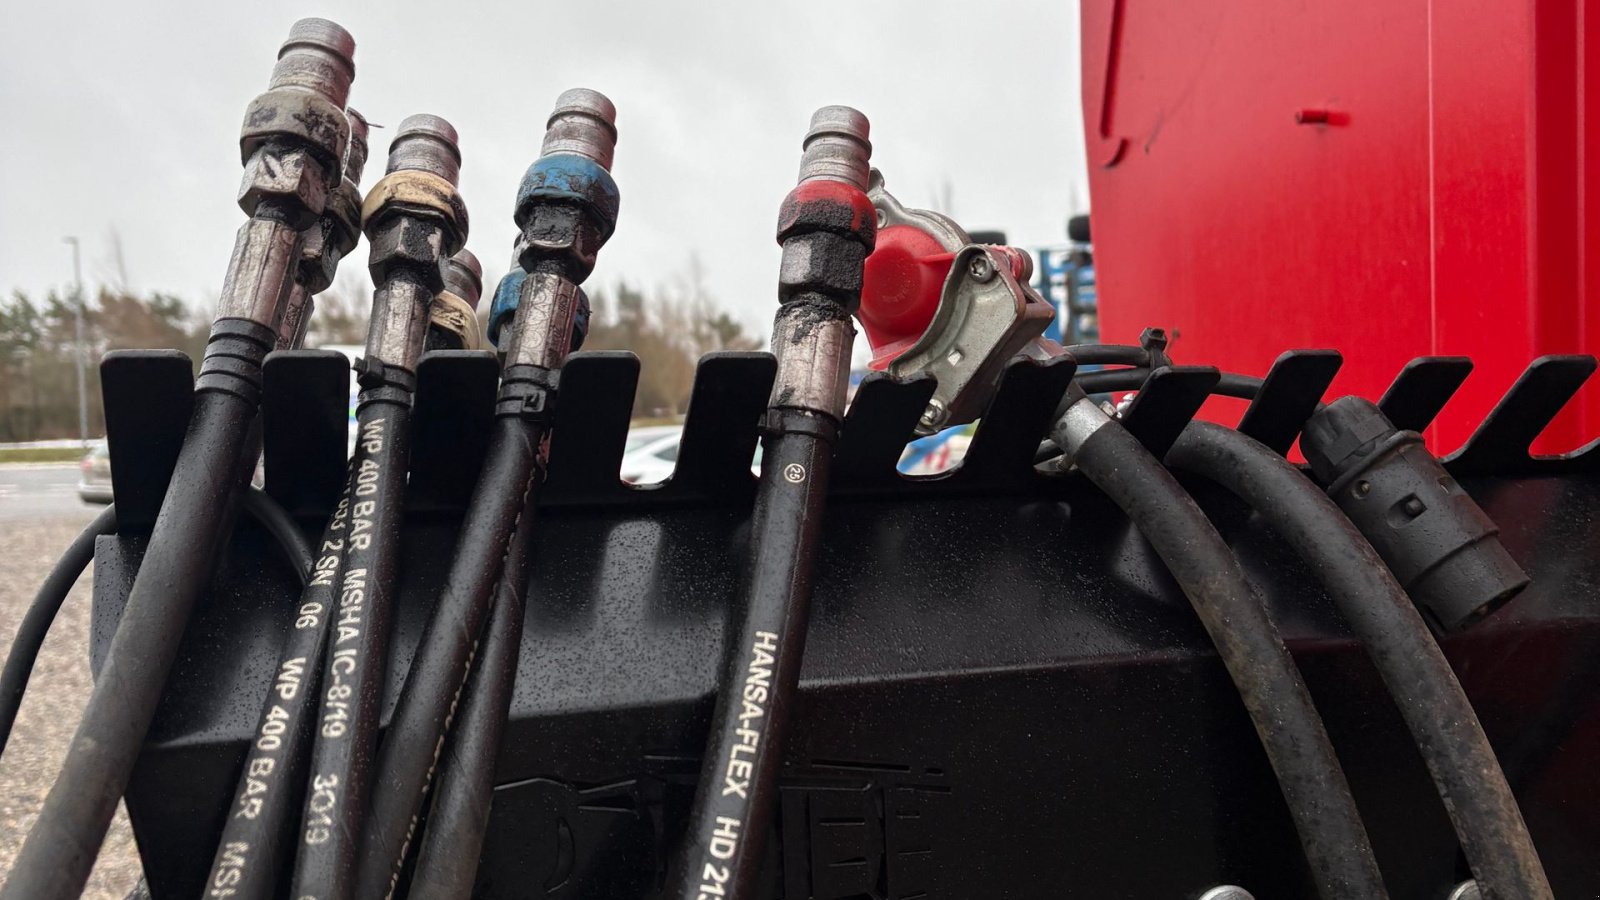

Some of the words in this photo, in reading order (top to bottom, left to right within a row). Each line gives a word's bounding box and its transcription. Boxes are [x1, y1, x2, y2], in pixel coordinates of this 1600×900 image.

[361, 418, 385, 454] WP
[355, 459, 380, 497] 400
[787, 465, 803, 481] 25
[321, 538, 344, 553] 2
[348, 500, 376, 554] BAR
[310, 555, 339, 586] SN
[295, 602, 323, 630] 06
[335, 568, 367, 646] MSHA
[275, 657, 306, 700] WP
[257, 705, 290, 751] 400
[722, 630, 778, 799] HANSA-FLEX
[234, 757, 276, 820] BAR
[709, 815, 741, 859] HD
